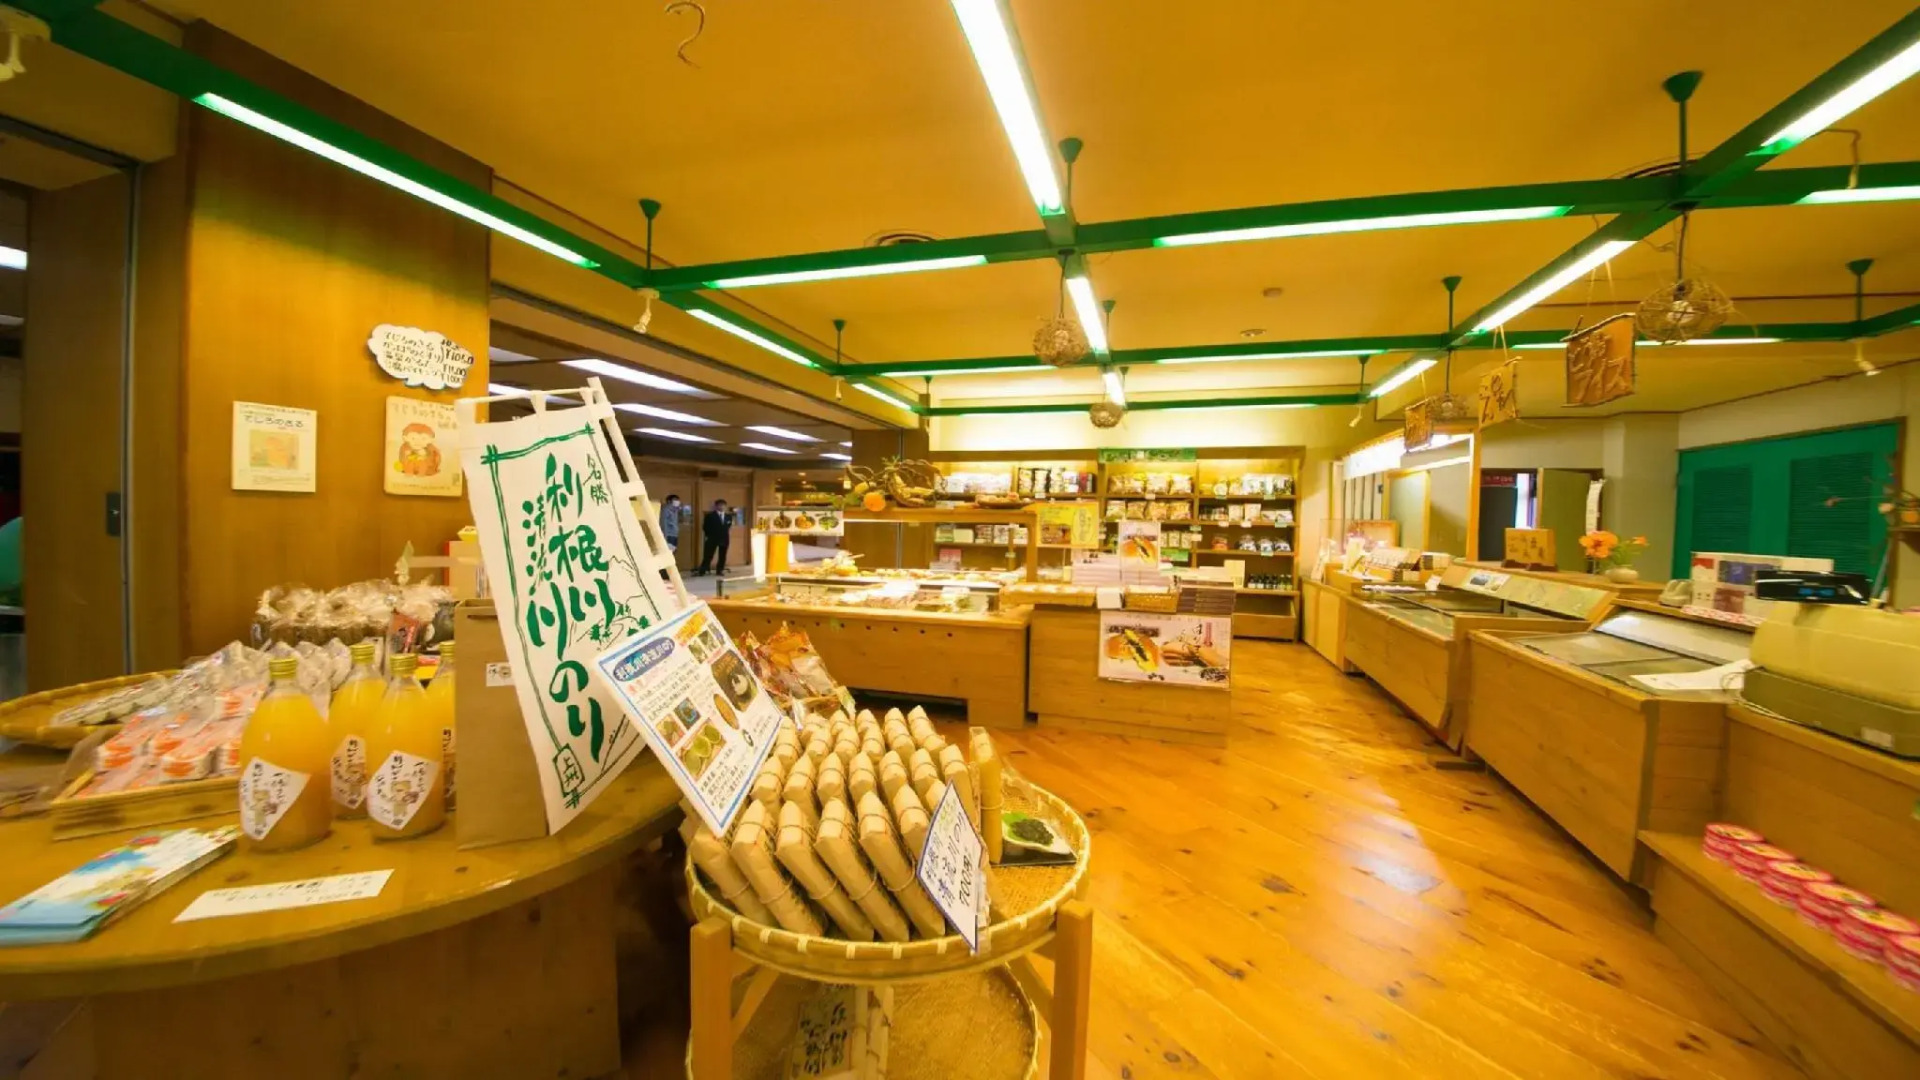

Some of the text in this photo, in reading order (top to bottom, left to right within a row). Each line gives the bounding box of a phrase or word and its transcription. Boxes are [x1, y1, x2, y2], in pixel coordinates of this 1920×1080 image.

[583, 453, 608, 506] 名勝
[546, 452, 615, 628] 利根川
